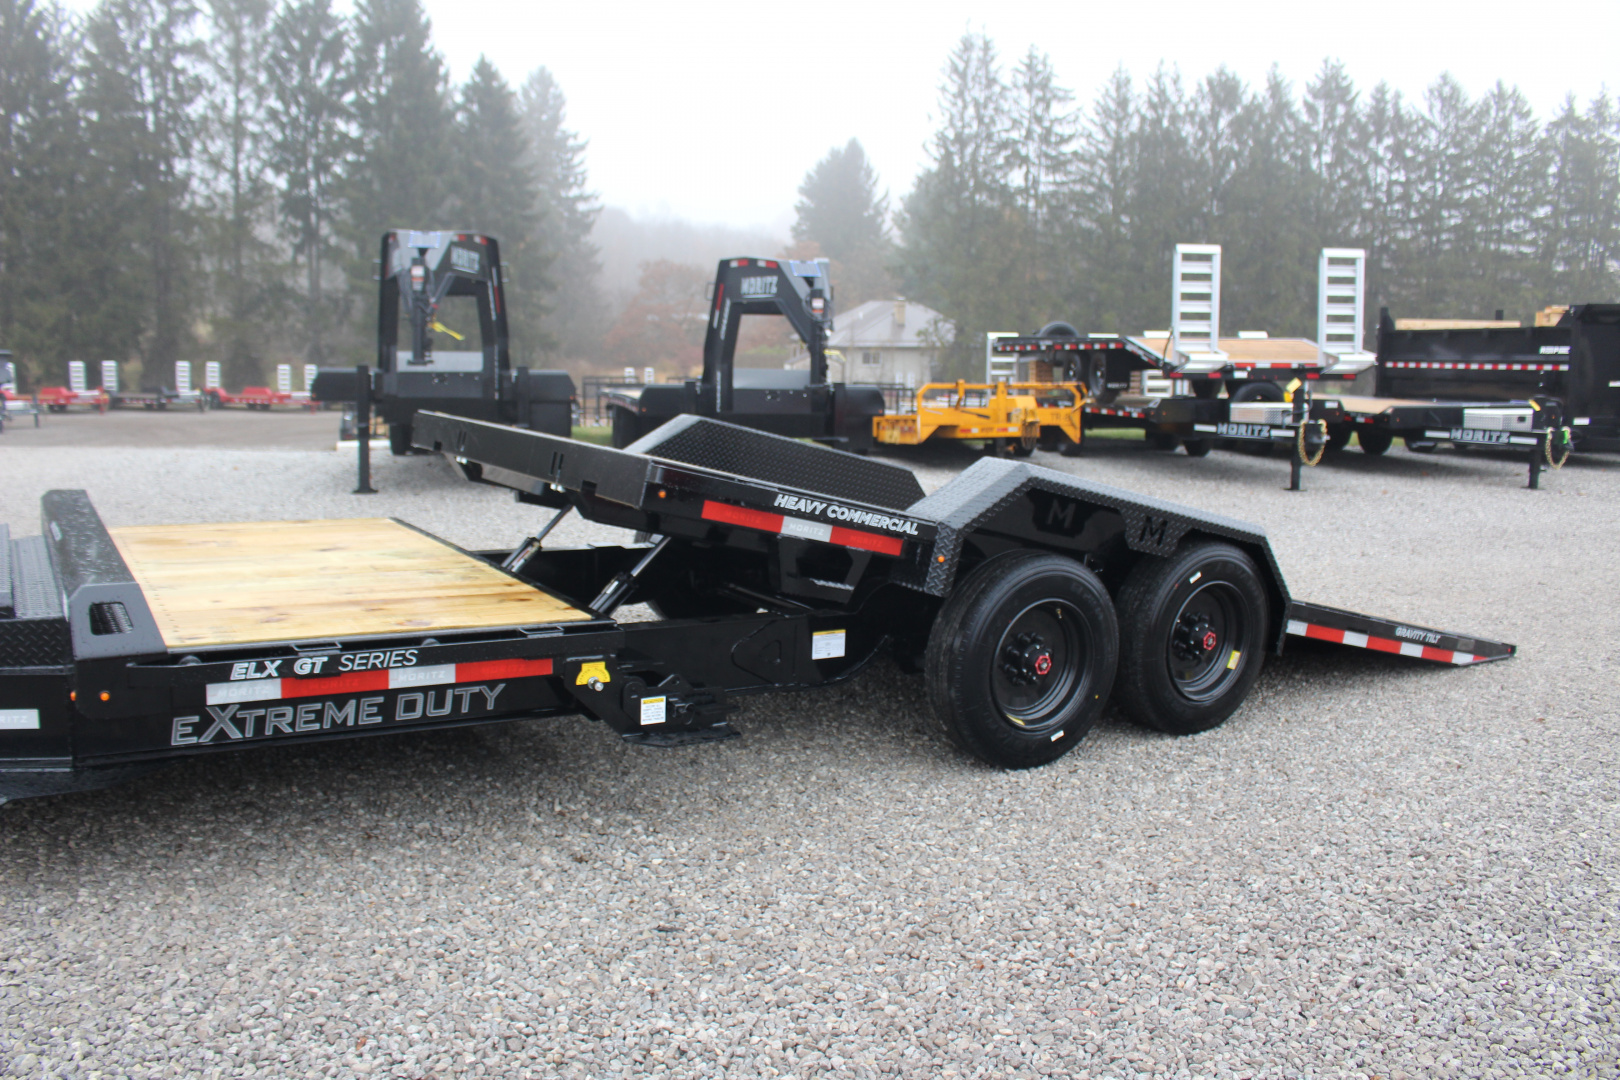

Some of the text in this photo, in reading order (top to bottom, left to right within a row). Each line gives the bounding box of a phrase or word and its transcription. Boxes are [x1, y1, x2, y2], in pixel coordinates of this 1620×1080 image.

[1217, 422, 1270, 438] MORITZ
[1451, 428, 1510, 443] MORITZ
[774, 494, 919, 536] HEAVY COMMERCIAL
[788, 522, 825, 536] MORITZ
[1140, 515, 1168, 546] M
[1395, 626, 1441, 644] GRAVITY TILT
[230, 649, 418, 681] ELX GT SERIES
[398, 670, 446, 682] MORITZ
[216, 687, 270, 698] MORITZ
[395, 683, 506, 721] DUTY
